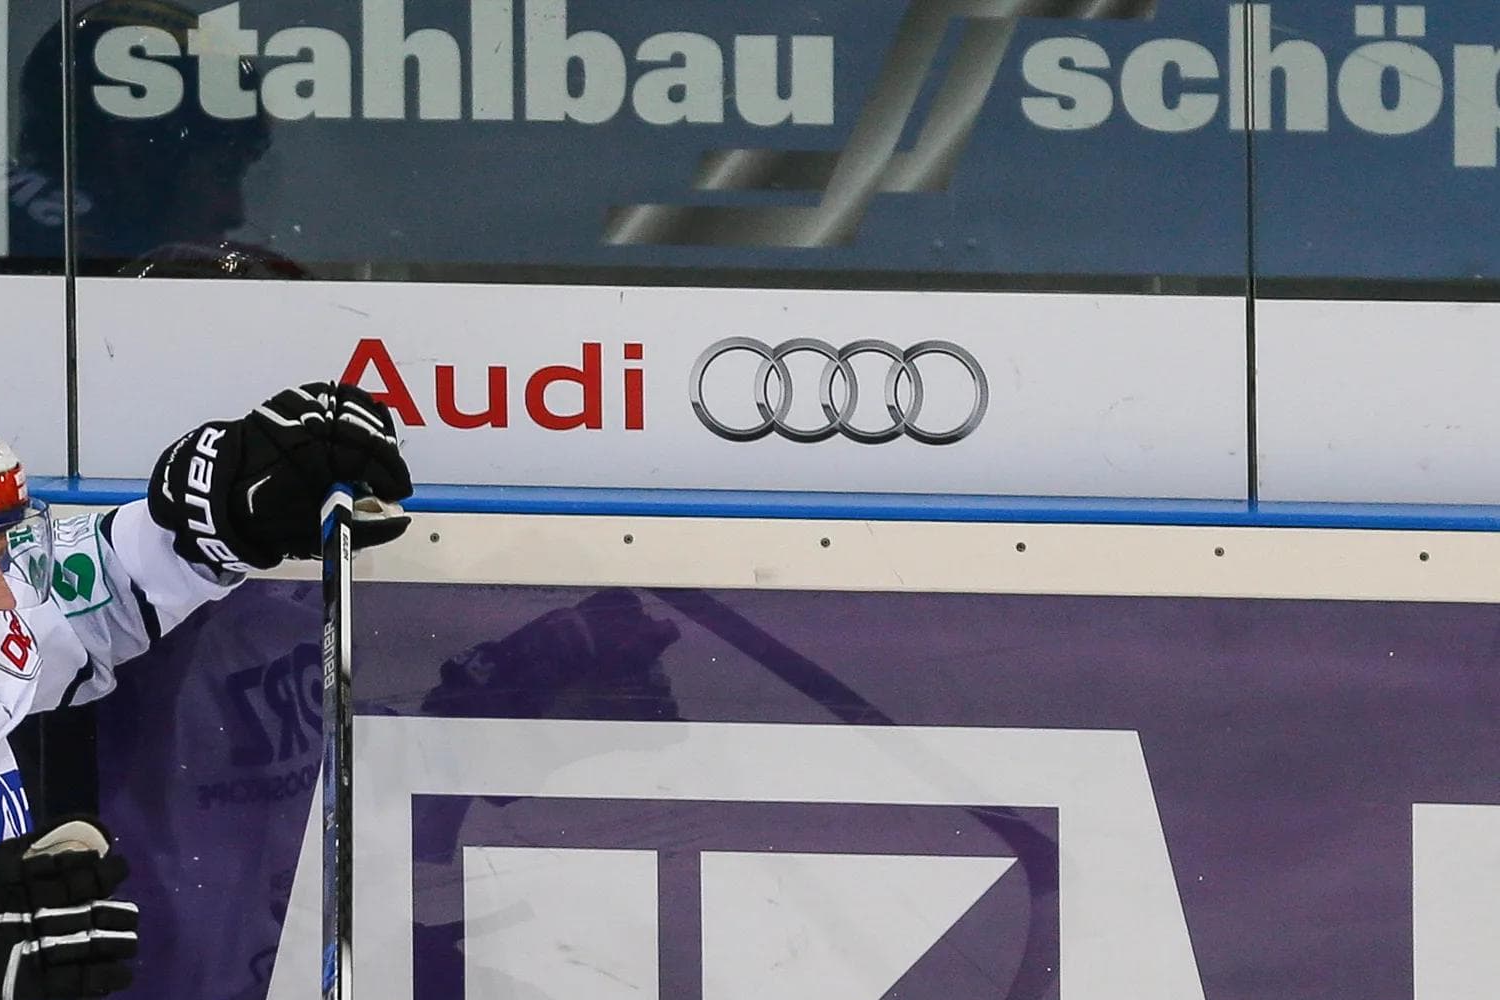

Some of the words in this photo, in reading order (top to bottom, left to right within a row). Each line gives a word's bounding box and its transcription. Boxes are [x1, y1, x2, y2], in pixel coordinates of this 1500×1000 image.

[92, 0, 835, 126] stahlbau
[338, 339, 644, 431] Audi
[323, 618, 335, 690] BAUER
